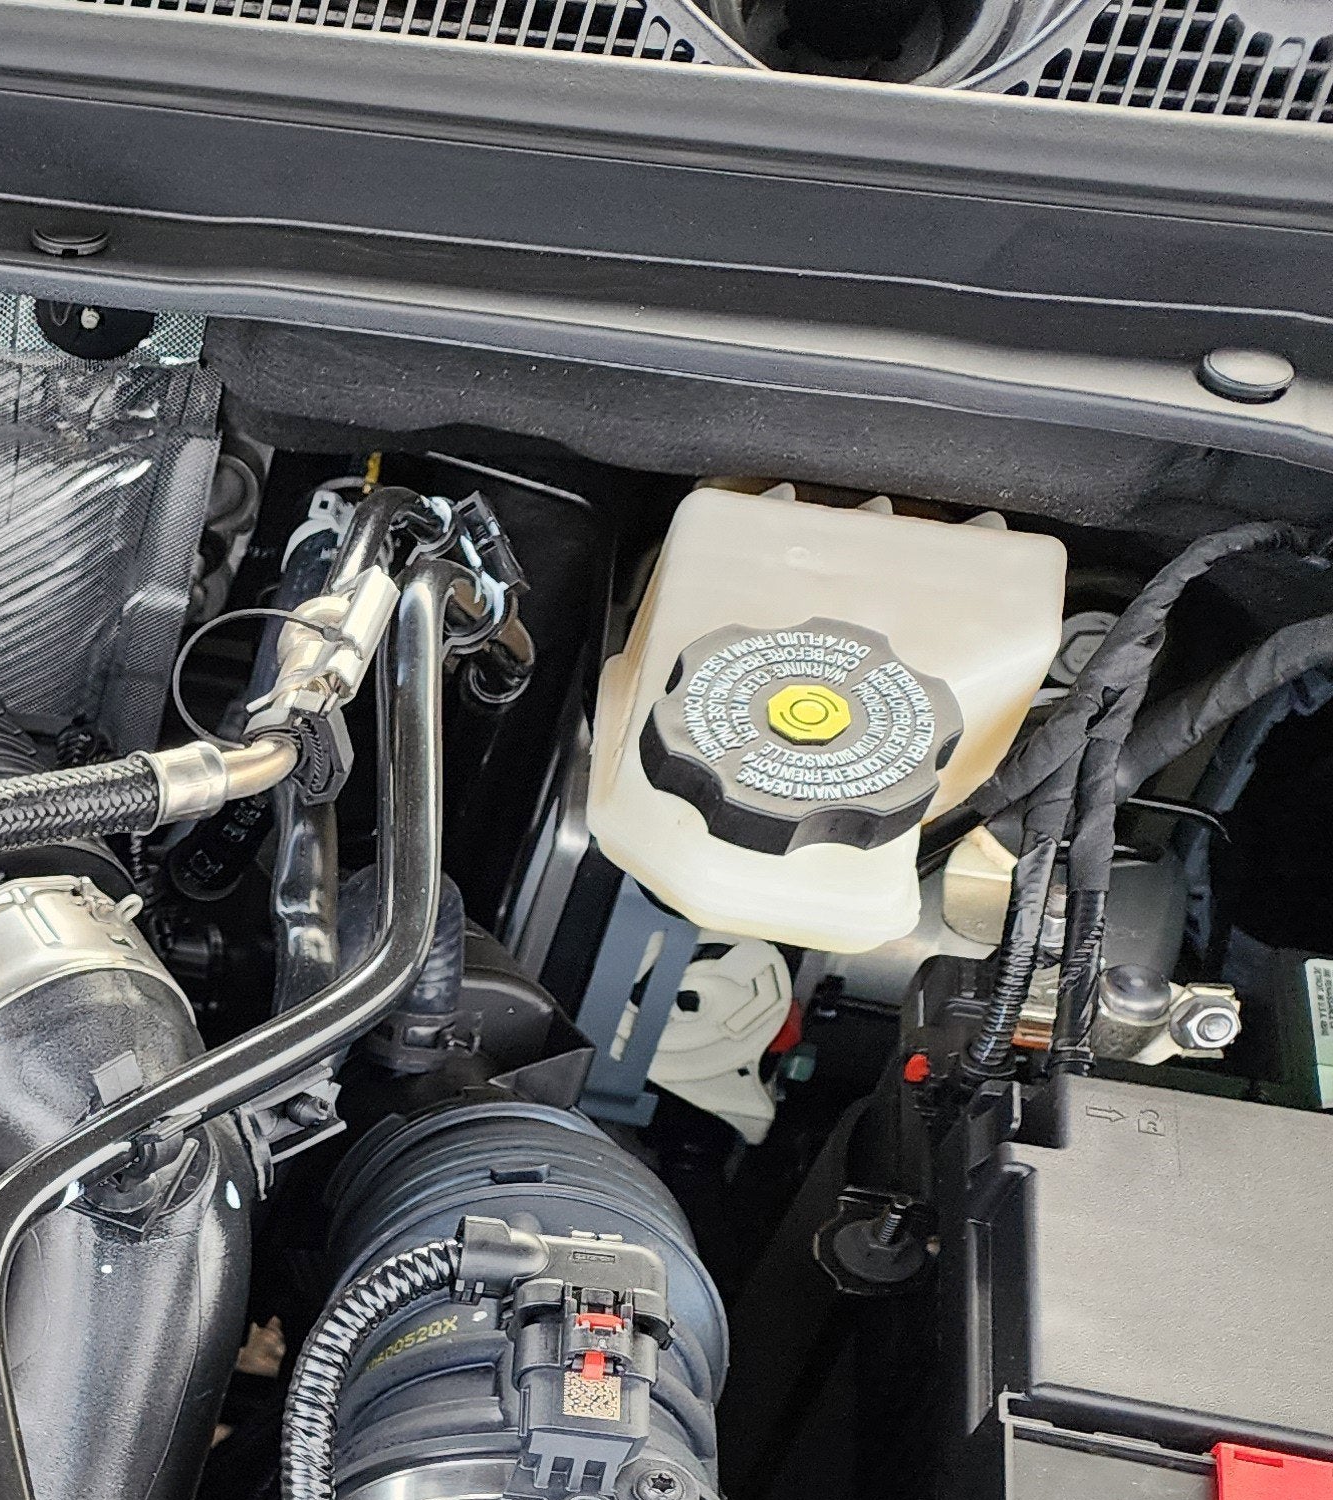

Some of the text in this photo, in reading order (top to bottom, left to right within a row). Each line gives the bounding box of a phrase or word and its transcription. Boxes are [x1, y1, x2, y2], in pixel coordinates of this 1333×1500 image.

[725, 632, 776, 656] FROM
[773, 631, 824, 646] FLUID
[758, 645, 826, 662] BEFORE
[824, 648, 862, 671] CAP
[685, 654, 728, 696] SEALED
[731, 668, 773, 704] CLEAN
[706, 696, 727, 720] USE
[848, 680, 886, 739] PROVENANT
[683, 693, 729, 764] CONTAINER
[728, 701, 762, 745] FILLER
[886, 724, 910, 746] QUE
[708, 720, 744, 753] ONLY
[903, 712, 933, 762] NETTOYER
[815, 747, 859, 767] BIDON
[838, 752, 892, 780] LIQUIDE
[776, 764, 823, 783] FREIN
[840, 765, 907, 797] BOUCHON
[790, 784, 844, 799] AVANT
